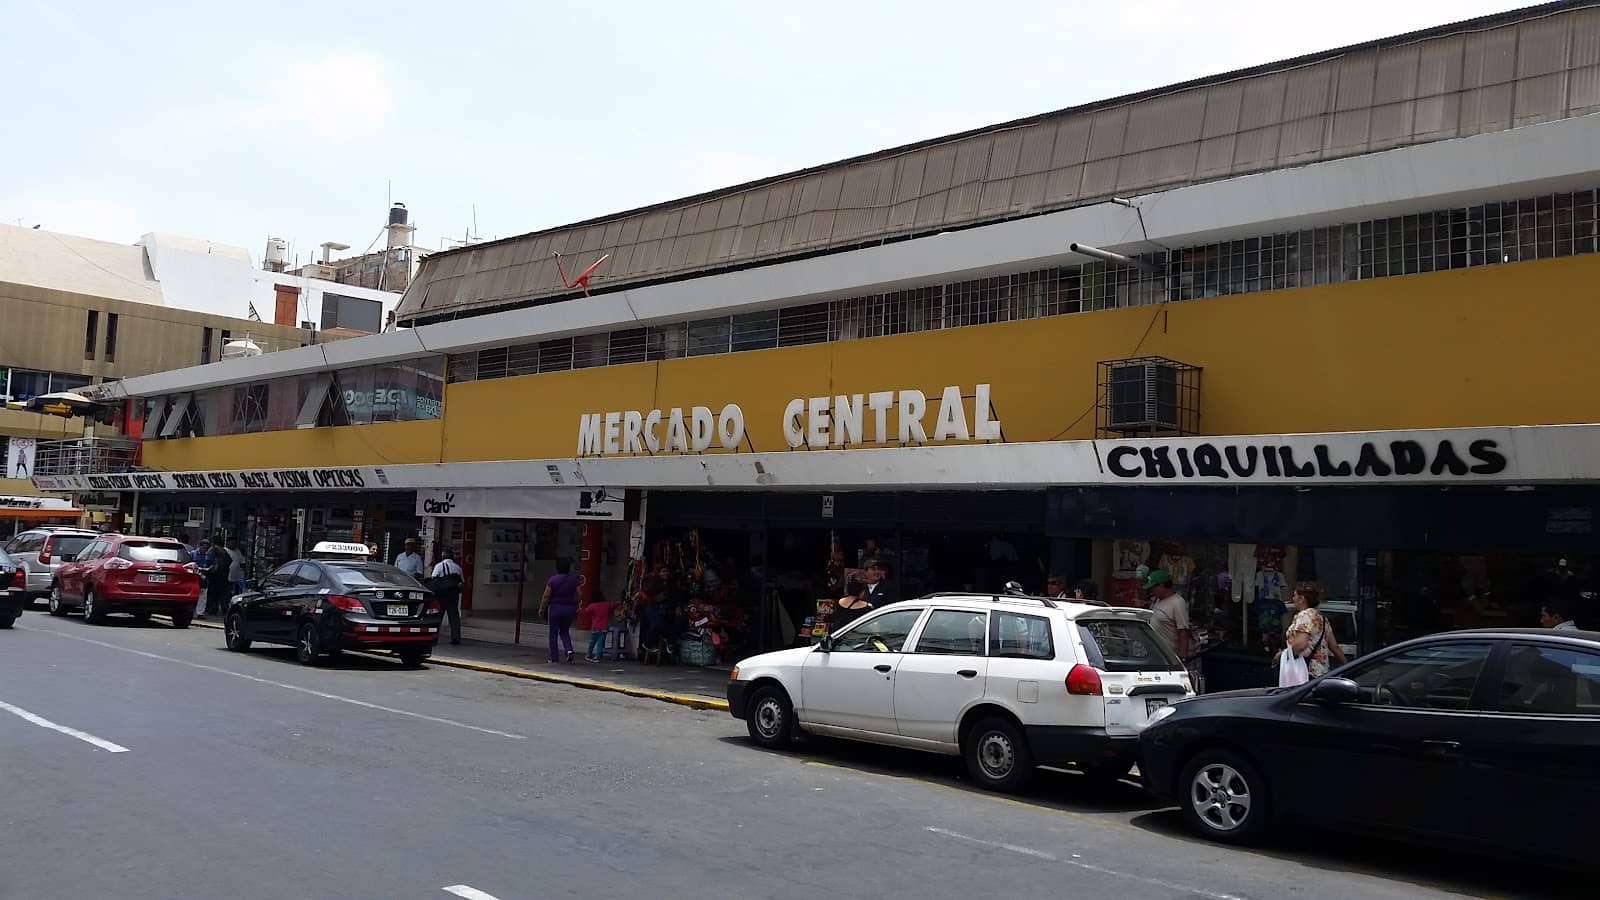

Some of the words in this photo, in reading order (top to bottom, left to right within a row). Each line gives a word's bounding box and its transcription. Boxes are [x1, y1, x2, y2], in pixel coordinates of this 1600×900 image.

[577, 403, 745, 456] MERCADO
[783, 383, 1000, 449] CENTRAL
[1107, 440, 1507, 479] CHIQUILLADAS
[274, 470, 313, 488] VISION
[312, 469, 365, 488] OPTICAS
[423, 496, 449, 512] Claro
